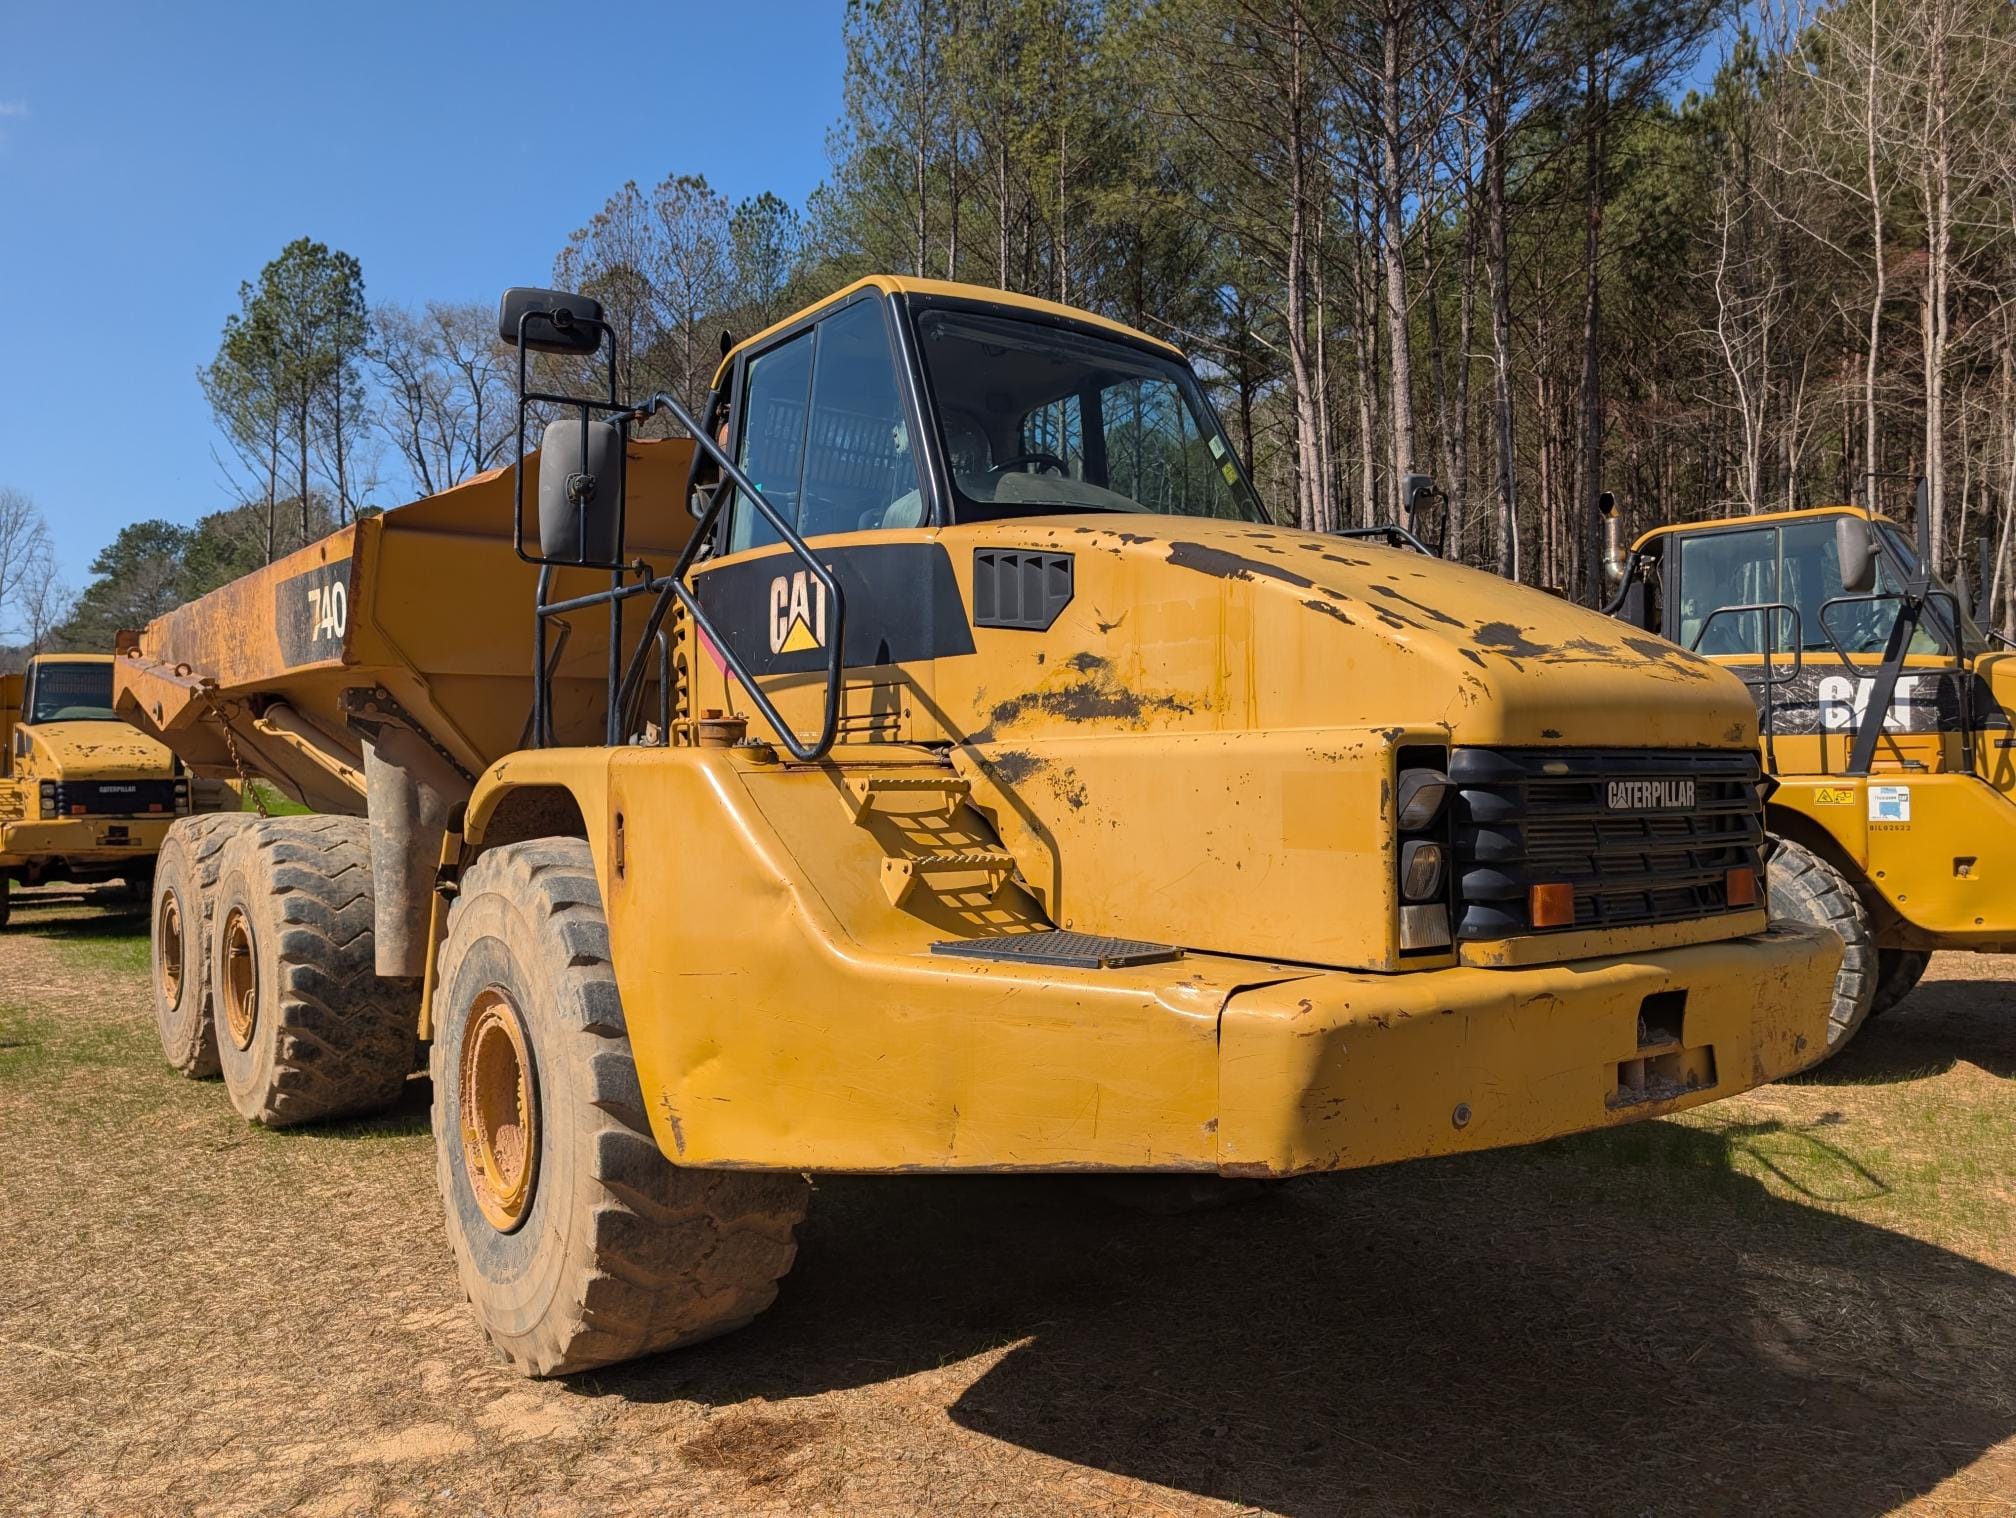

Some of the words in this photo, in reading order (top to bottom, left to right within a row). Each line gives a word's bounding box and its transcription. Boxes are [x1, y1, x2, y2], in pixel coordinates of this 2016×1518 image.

[308, 581, 347, 641] 740
[770, 564, 833, 655] CAT
[1608, 781, 1695, 808] CATERPILLAR
